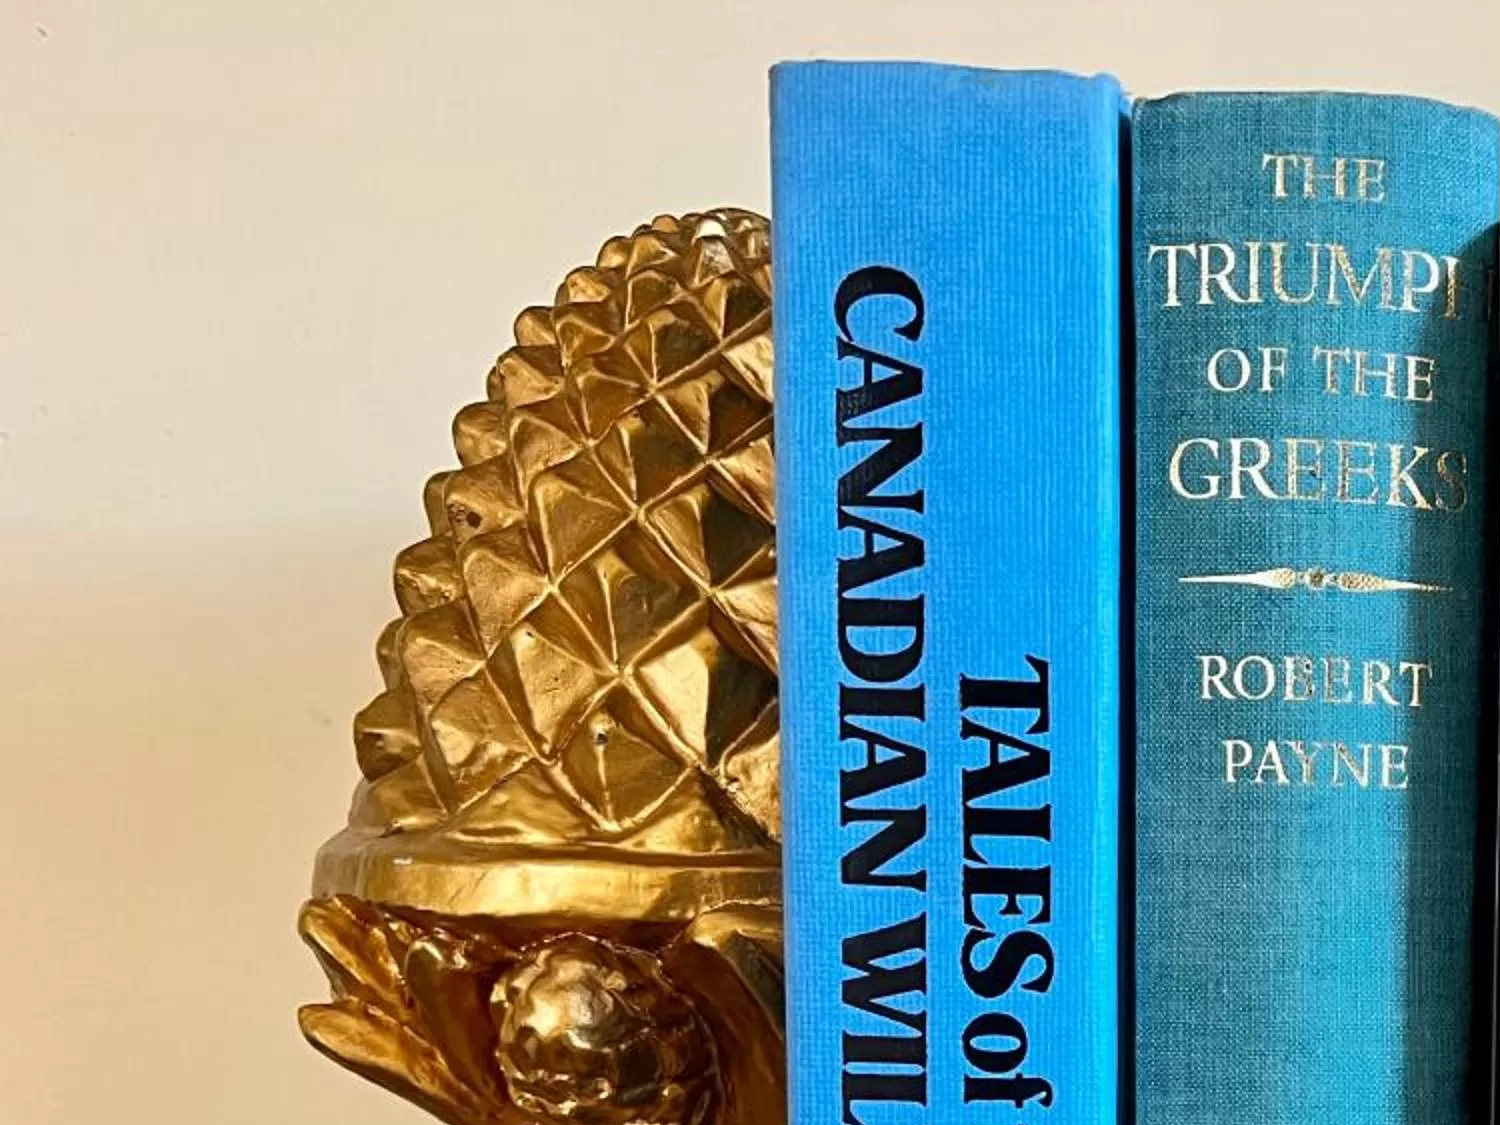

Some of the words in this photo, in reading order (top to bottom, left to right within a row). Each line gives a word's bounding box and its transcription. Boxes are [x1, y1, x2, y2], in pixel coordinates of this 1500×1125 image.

[1262, 151, 1385, 202] THE
[1207, 346, 1289, 393] OF
[1313, 346, 1436, 402] THE
[1168, 436, 1468, 513] GREEKS
[834, 265, 927, 891] CANADIAN
[1197, 654, 1433, 708] ROBERT
[1222, 739, 1410, 790] PAYNE
[959, 655, 1054, 998] TALES
[962, 1011, 1053, 1109] of
